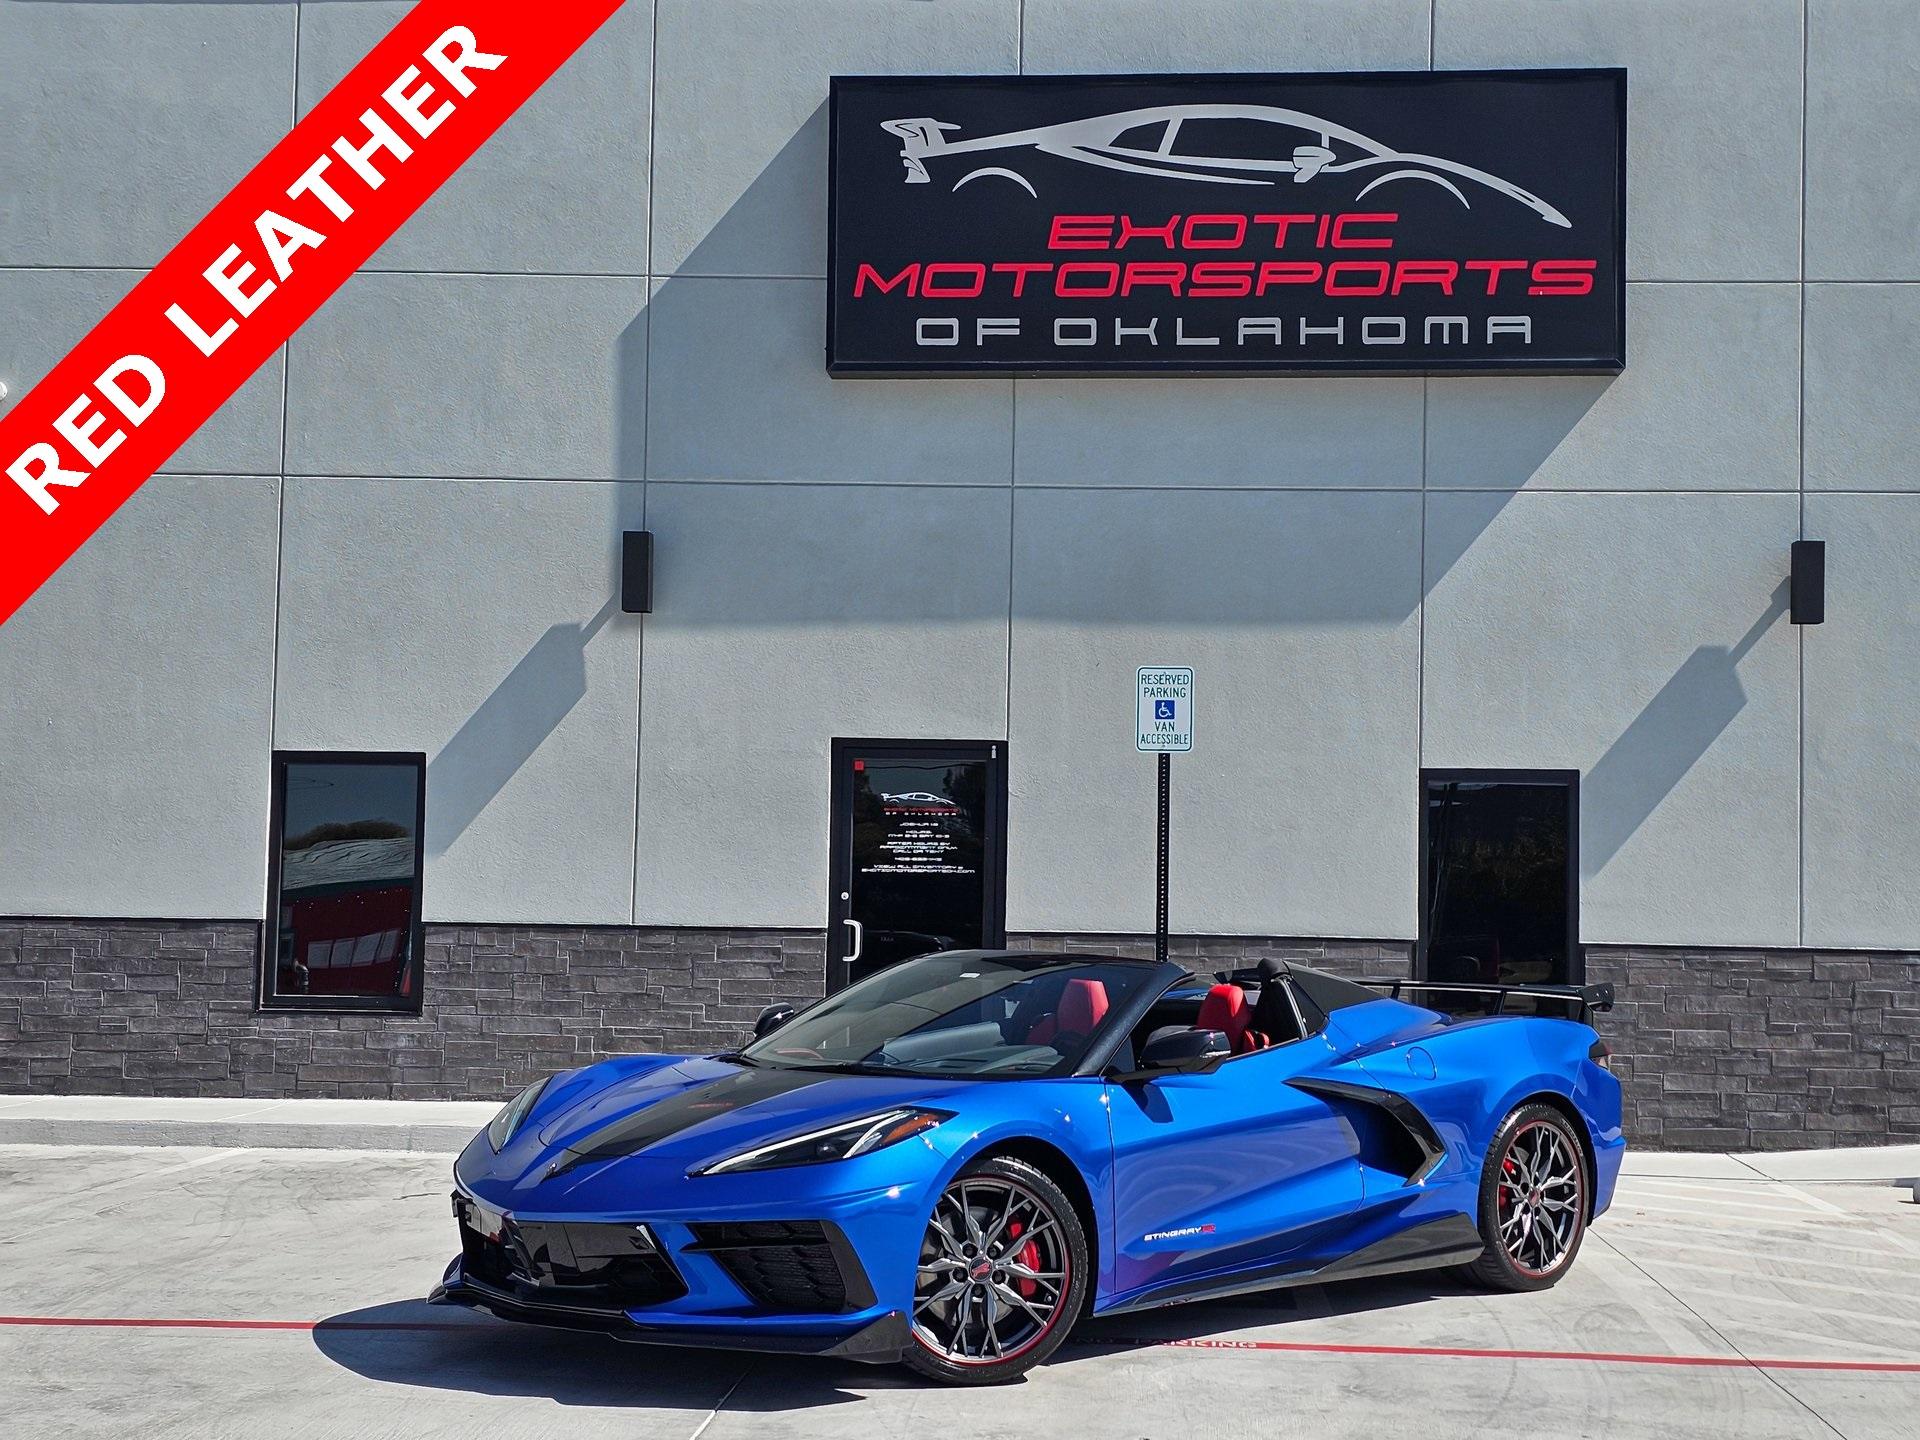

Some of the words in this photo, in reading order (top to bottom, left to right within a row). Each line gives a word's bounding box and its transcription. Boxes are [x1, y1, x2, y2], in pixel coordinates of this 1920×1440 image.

[1047, 212, 1399, 250] EXOTIC
[852, 258, 1597, 298] MOTORSPORTS
[915, 316, 1021, 346] OF
[1053, 315, 1533, 347] OKLAHOMA
[1140, 674, 1190, 685] RESERVED
[1143, 687, 1187, 698] PARKING
[1154, 721, 1175, 732] VAN
[1140, 733, 1189, 744] ACCESSIBLE
[1143, 1226, 1202, 1241] STINGRAY
